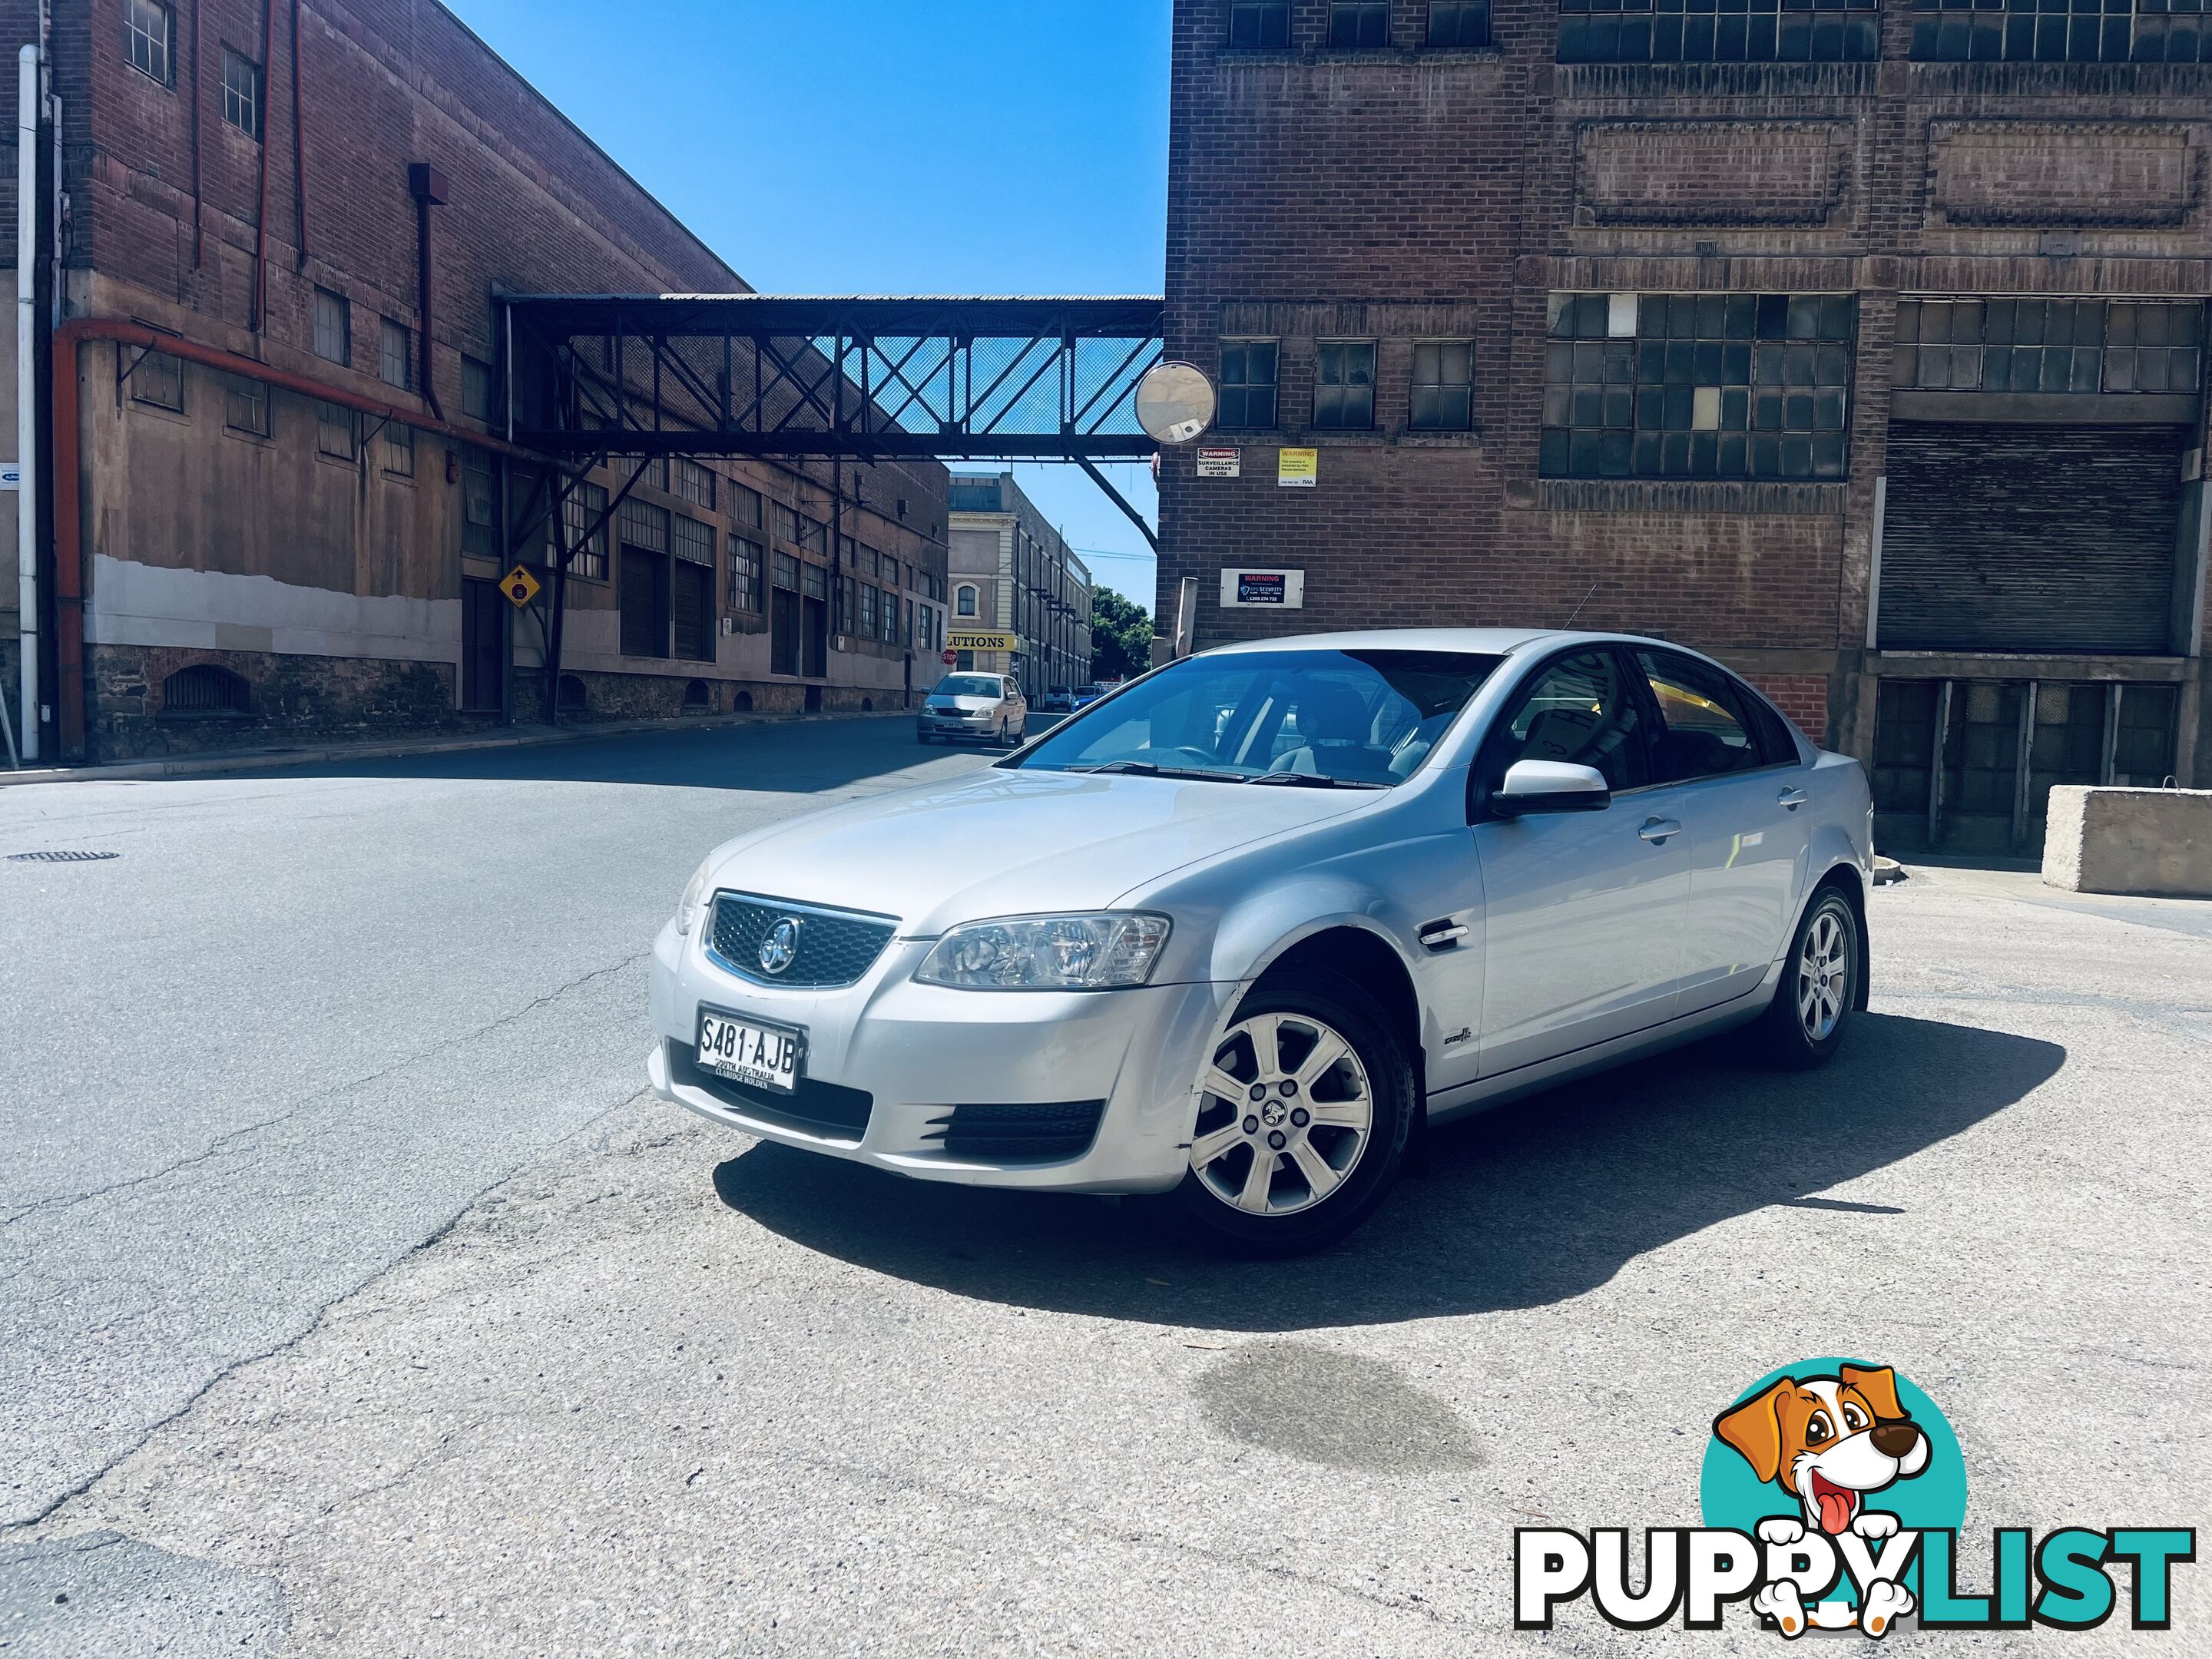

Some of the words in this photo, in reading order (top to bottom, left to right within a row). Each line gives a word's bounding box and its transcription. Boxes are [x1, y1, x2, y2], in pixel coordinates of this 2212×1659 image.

[715, 1058, 737, 1071] SOUTH
[737, 1065, 775, 1083] AUSTRALIA
[715, 1068, 744, 1083] CLARIDGE
[743, 1075, 768, 1090] HOLDEN
